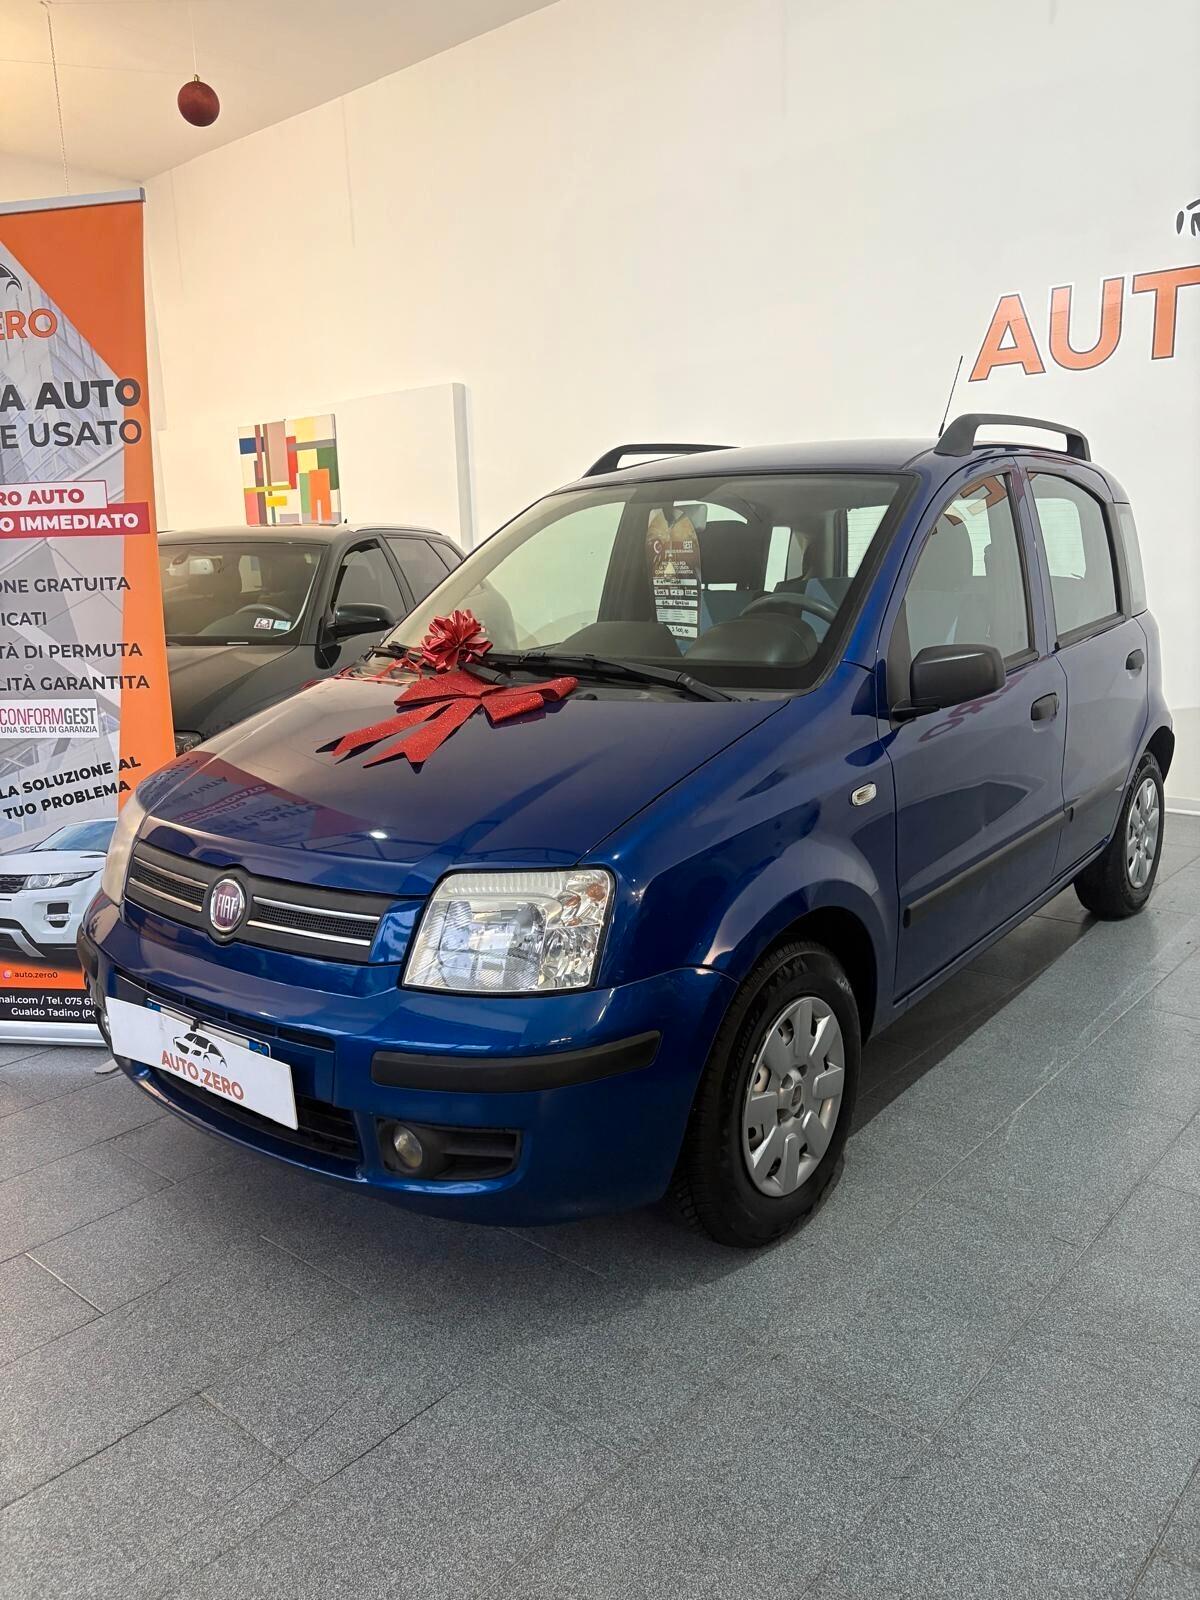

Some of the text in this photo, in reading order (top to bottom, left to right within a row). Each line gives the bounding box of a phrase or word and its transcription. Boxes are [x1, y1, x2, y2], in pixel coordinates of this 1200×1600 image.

[968, 264, 1200, 382] AUT
[35, 378, 141, 410] AUTO
[28, 419, 142, 447] USATO
[28, 488, 85, 505] AUTO
[20, 513, 139, 532] IMMEDIATO
[0, 577, 131, 594] NE GRATUITA
[1, 611, 47, 626] ICATI
[24, 645, 43, 659] DI
[48, 643, 143, 659] PERMUTA
[40, 675, 150, 691] GARANTITA
[0, 708, 96, 725] CONFORMGEST
[0, 756, 141, 799] LA SOLUZIONE AL
[3, 780, 131, 820] TUO PROBLEMA
[216, 893, 238, 920] FIAT
[15, 971, 58, 979] auto.zero0
[46, 996, 63, 1005] Tel.
[65, 997, 82, 1005] 075
[84, 997, 96, 1006] 61
[11, 1007, 45, 1016] Gualdo
[47, 1008, 80, 1017] Tadino
[161, 1050, 245, 1101] AUTO.ZERO
